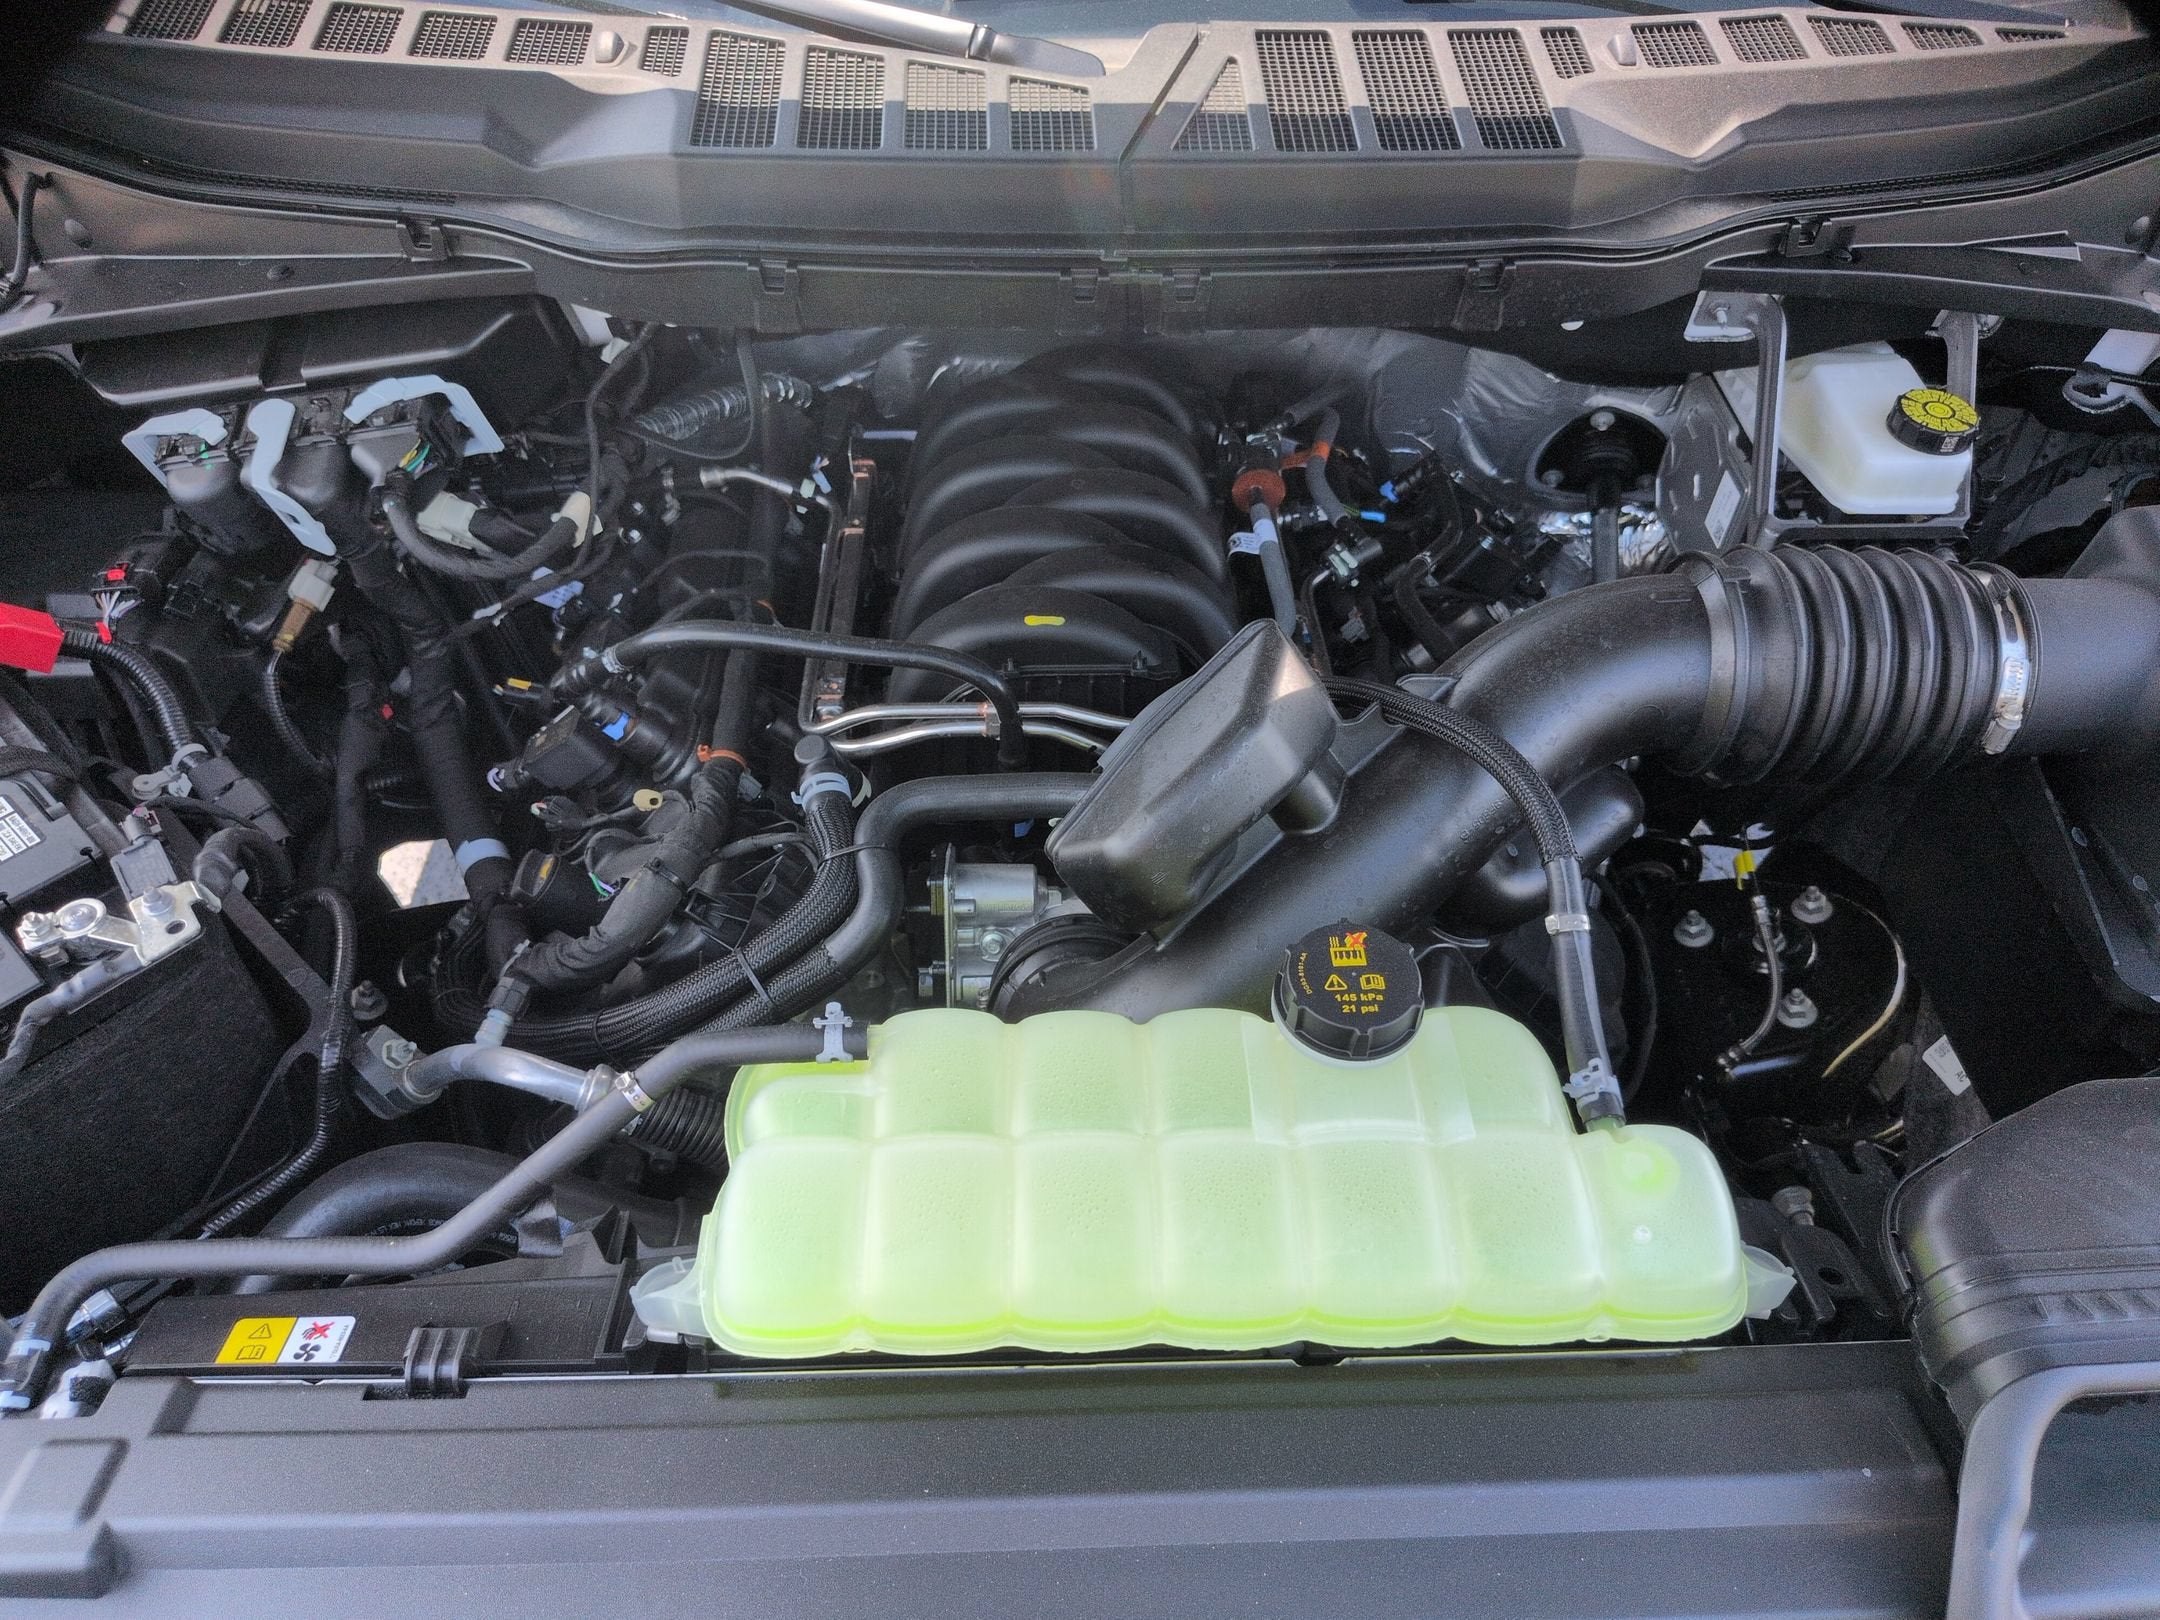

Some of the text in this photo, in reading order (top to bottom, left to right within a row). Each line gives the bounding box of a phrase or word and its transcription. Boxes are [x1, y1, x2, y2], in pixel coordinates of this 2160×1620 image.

[1334, 992, 1384, 1002] 145 kPa
[1342, 1003, 1379, 1014] 21 psi
